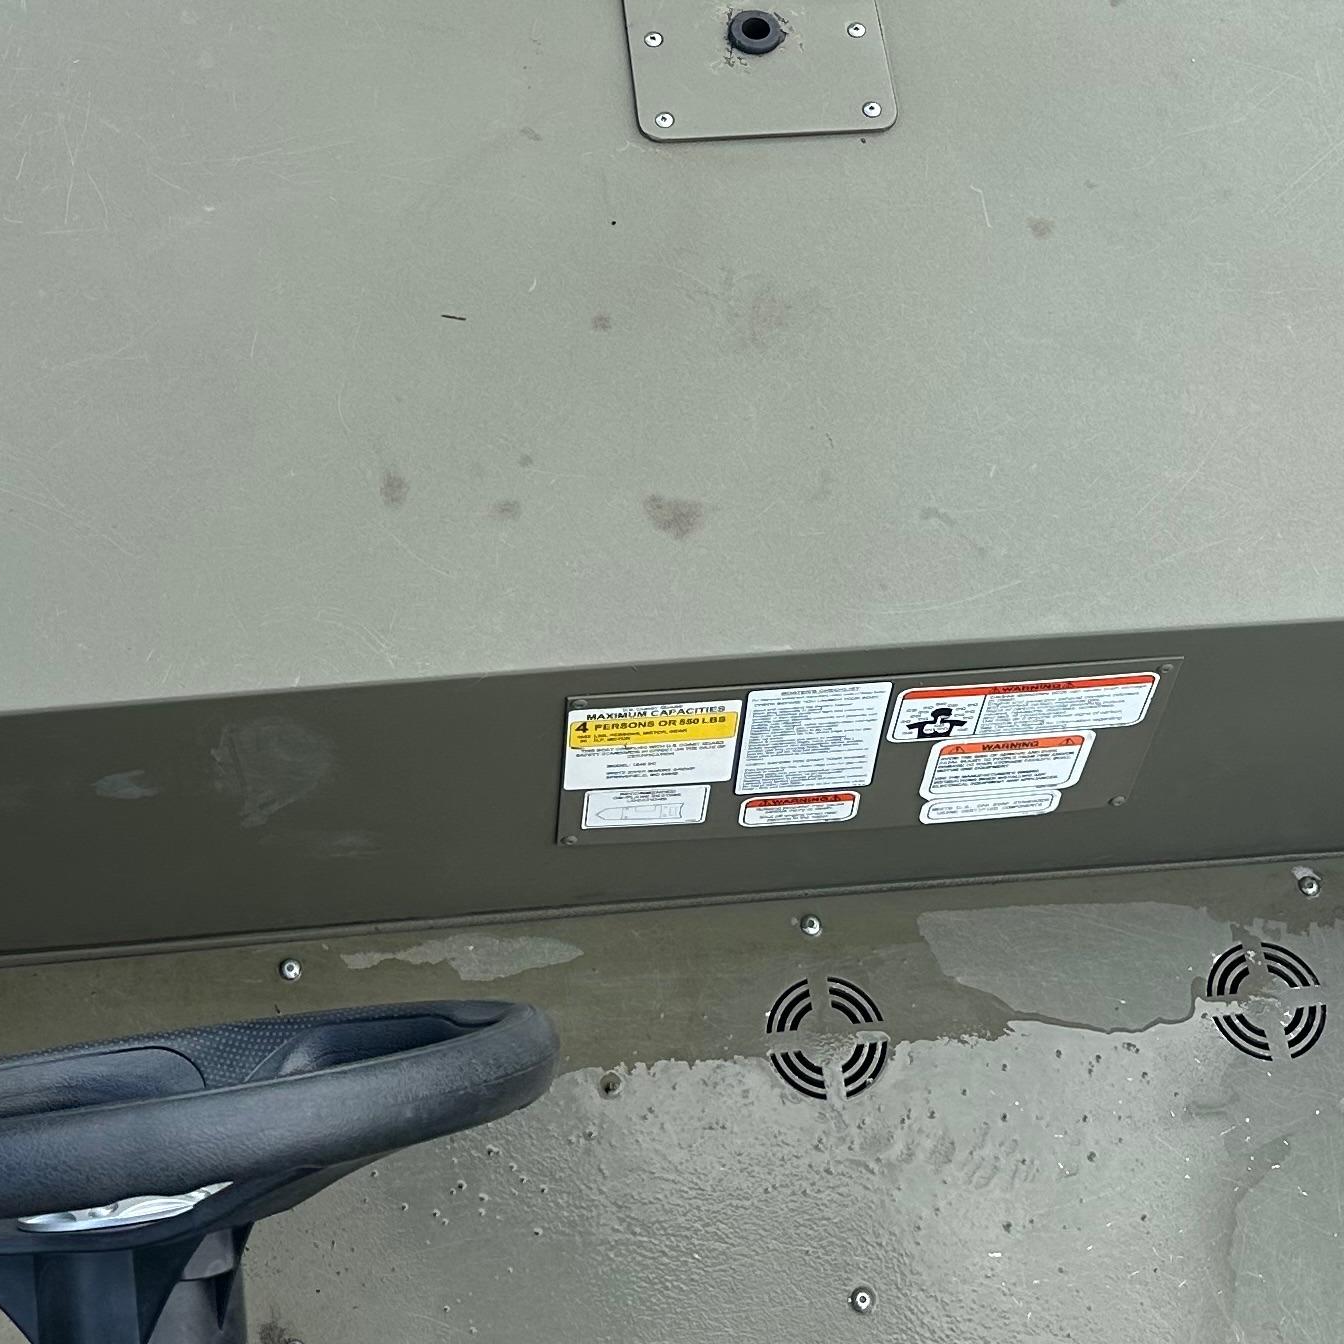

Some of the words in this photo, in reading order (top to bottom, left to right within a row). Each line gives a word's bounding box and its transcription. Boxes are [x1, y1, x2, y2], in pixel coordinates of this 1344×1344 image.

[586, 710, 647, 721] MAXIMUM
[650, 705, 726, 717] CAPACITIES
[575, 721, 589, 733] 4
[594, 720, 655, 732] PERSONS
[658, 719, 677, 727] OR
[701, 716, 726, 725] LBS
[982, 740, 1039, 751] WARNING
